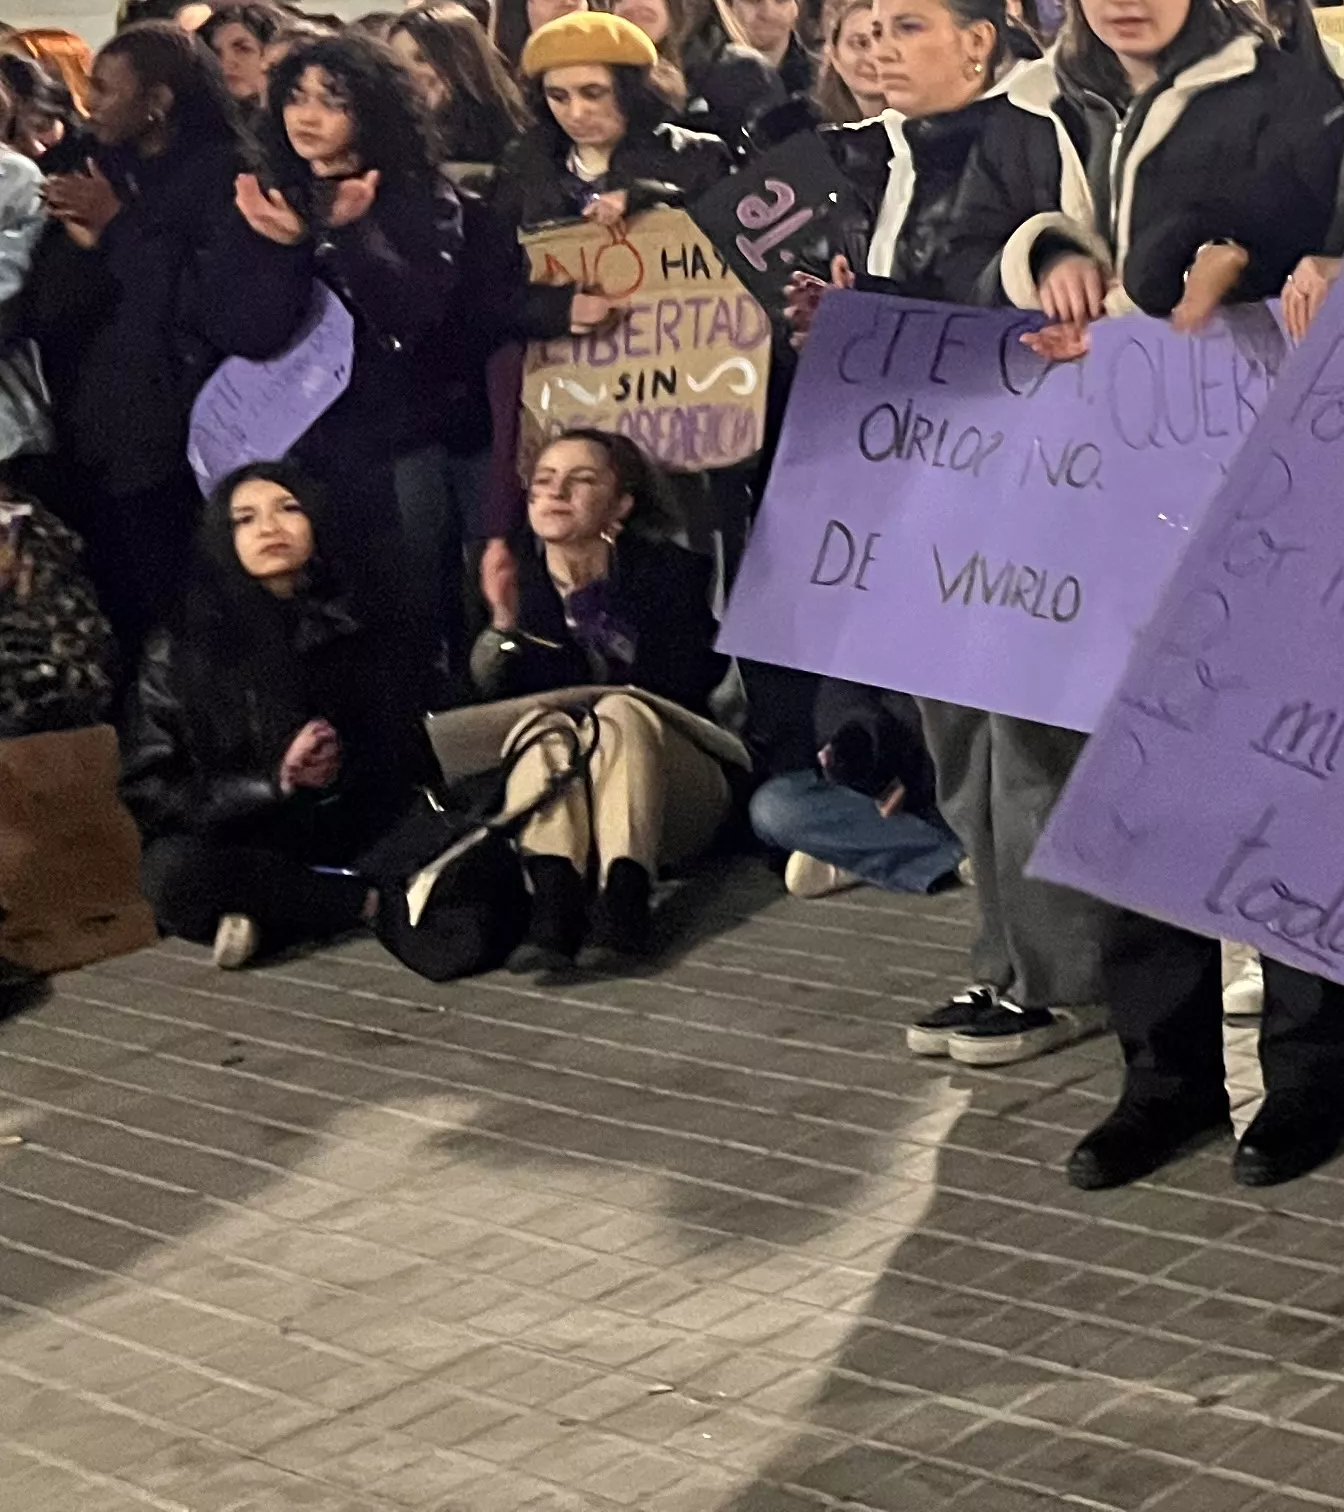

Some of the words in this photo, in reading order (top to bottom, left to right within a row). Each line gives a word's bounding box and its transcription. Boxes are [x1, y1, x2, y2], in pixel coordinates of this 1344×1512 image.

[613, 364, 678, 405] SIN
[810, 519, 882, 591] DE
[933, 543, 1083, 623] VIVIRLO
